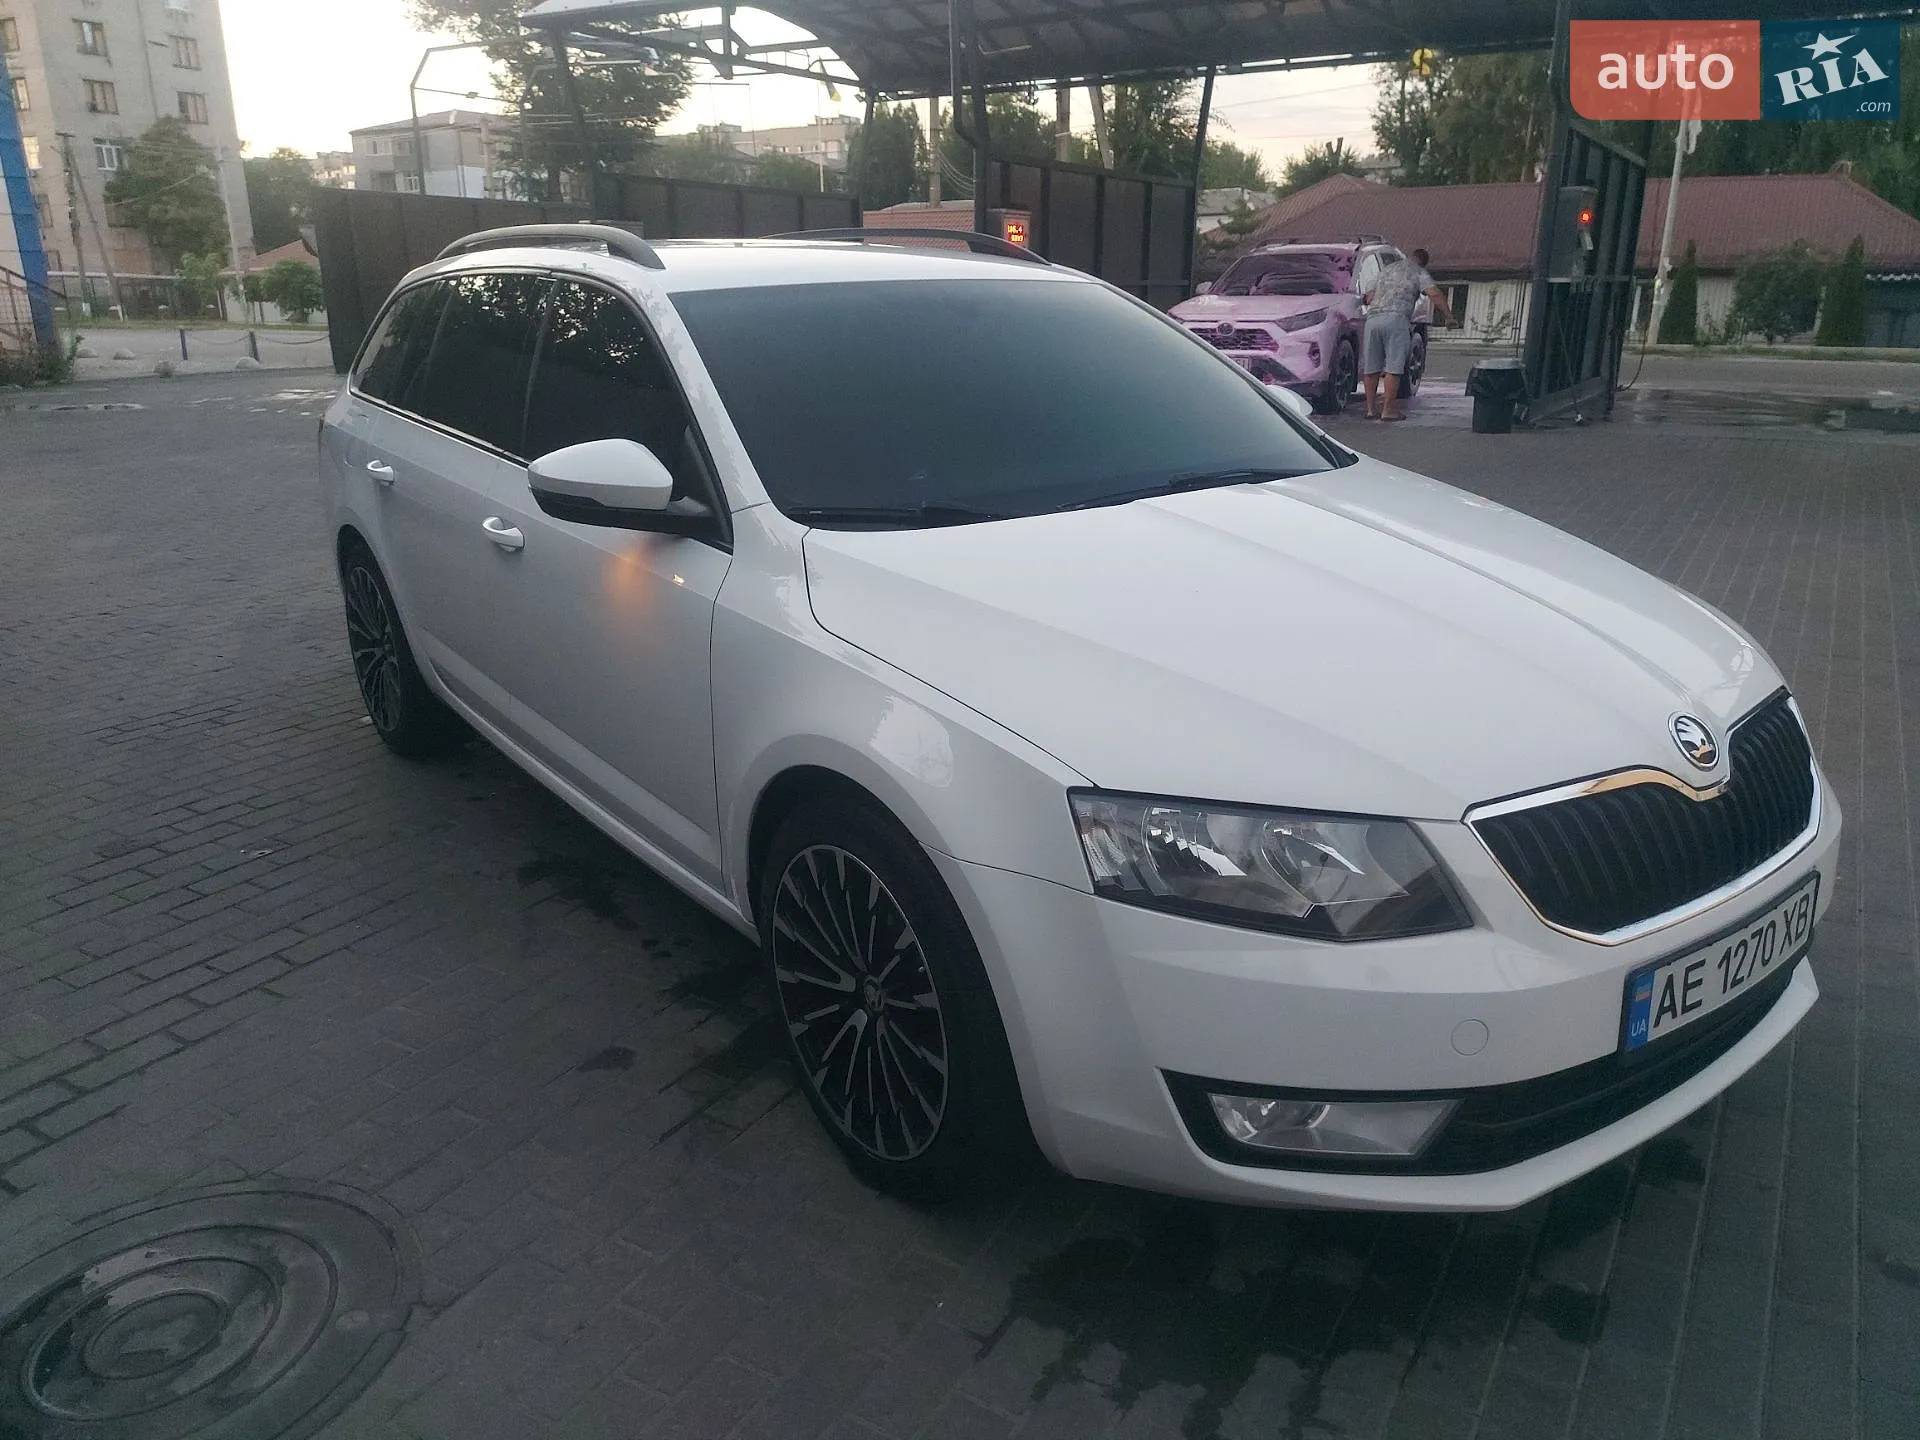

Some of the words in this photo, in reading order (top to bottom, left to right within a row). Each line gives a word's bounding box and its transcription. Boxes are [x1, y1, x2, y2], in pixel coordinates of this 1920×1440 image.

[1653, 958, 1706, 1028] AE
[1717, 919, 1777, 994] 1270
[1779, 893, 1810, 957] XB
[1631, 1018, 1647, 1036] UA
